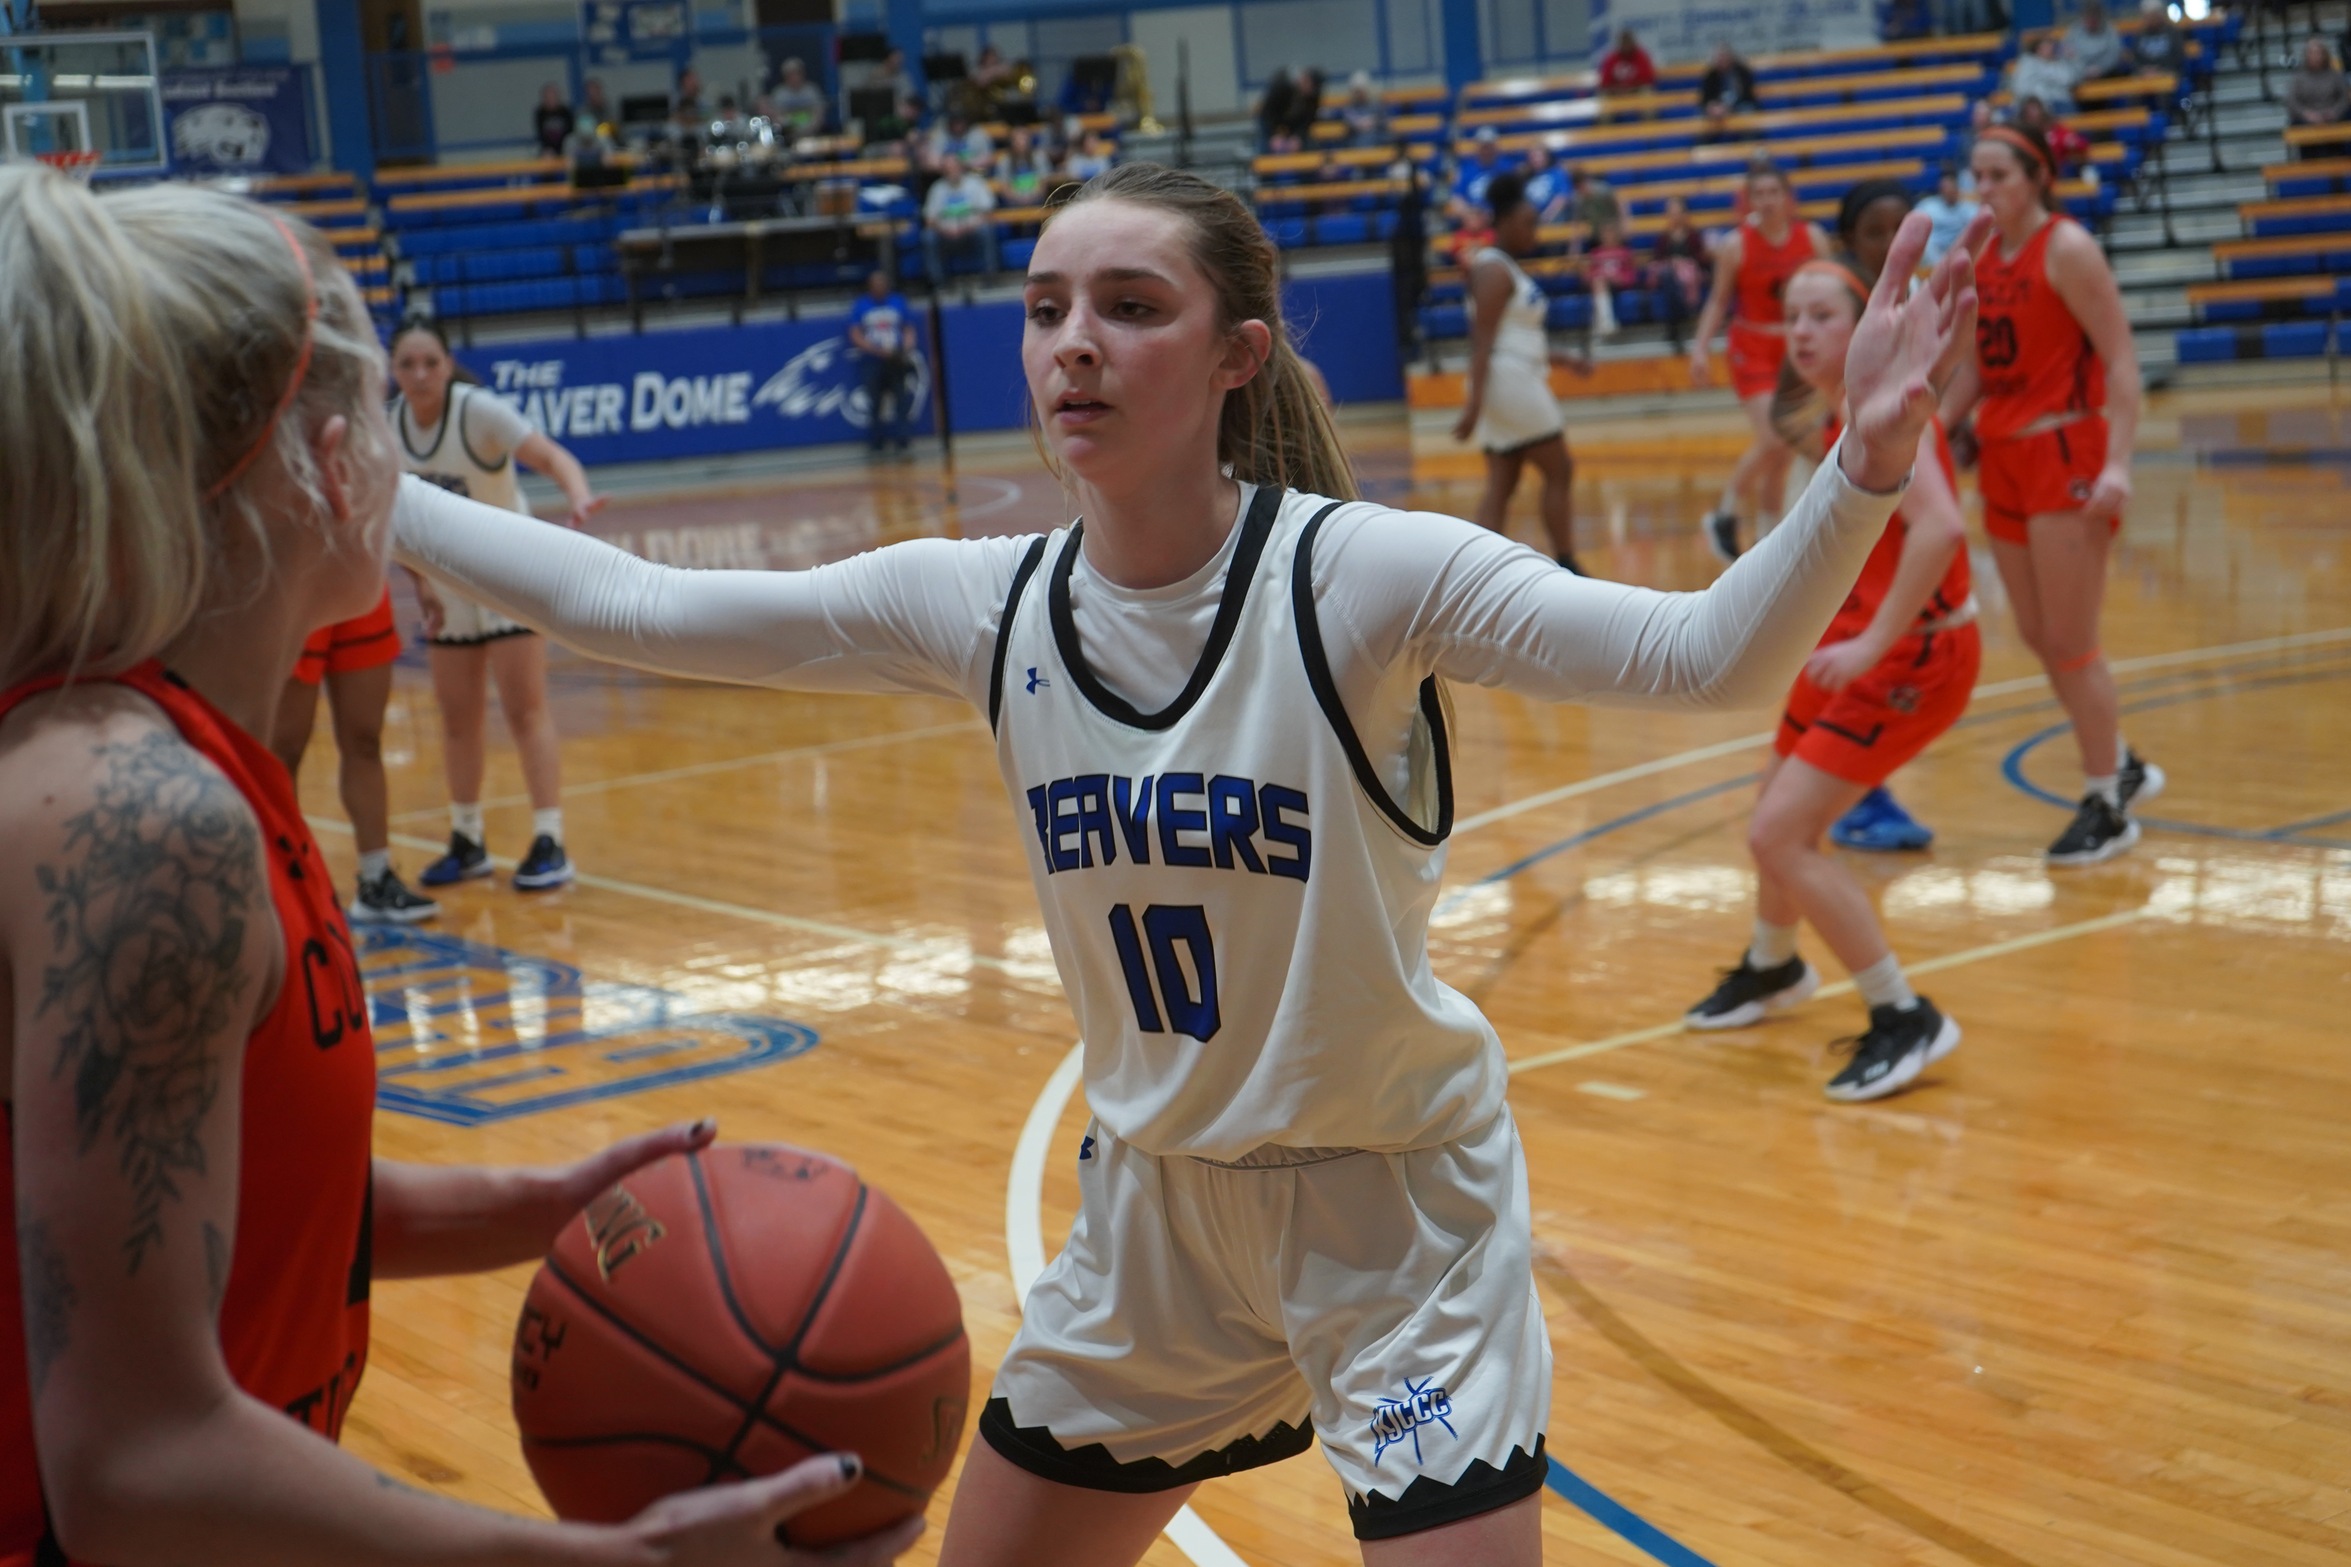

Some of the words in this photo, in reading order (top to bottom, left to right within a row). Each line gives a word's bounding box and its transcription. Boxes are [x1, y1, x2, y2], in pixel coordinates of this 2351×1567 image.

[491, 358, 564, 389] THE
[630, 371, 752, 431] DOME
[1026, 772, 1312, 884] BEAVERS
[1107, 903, 1222, 1044] 10
